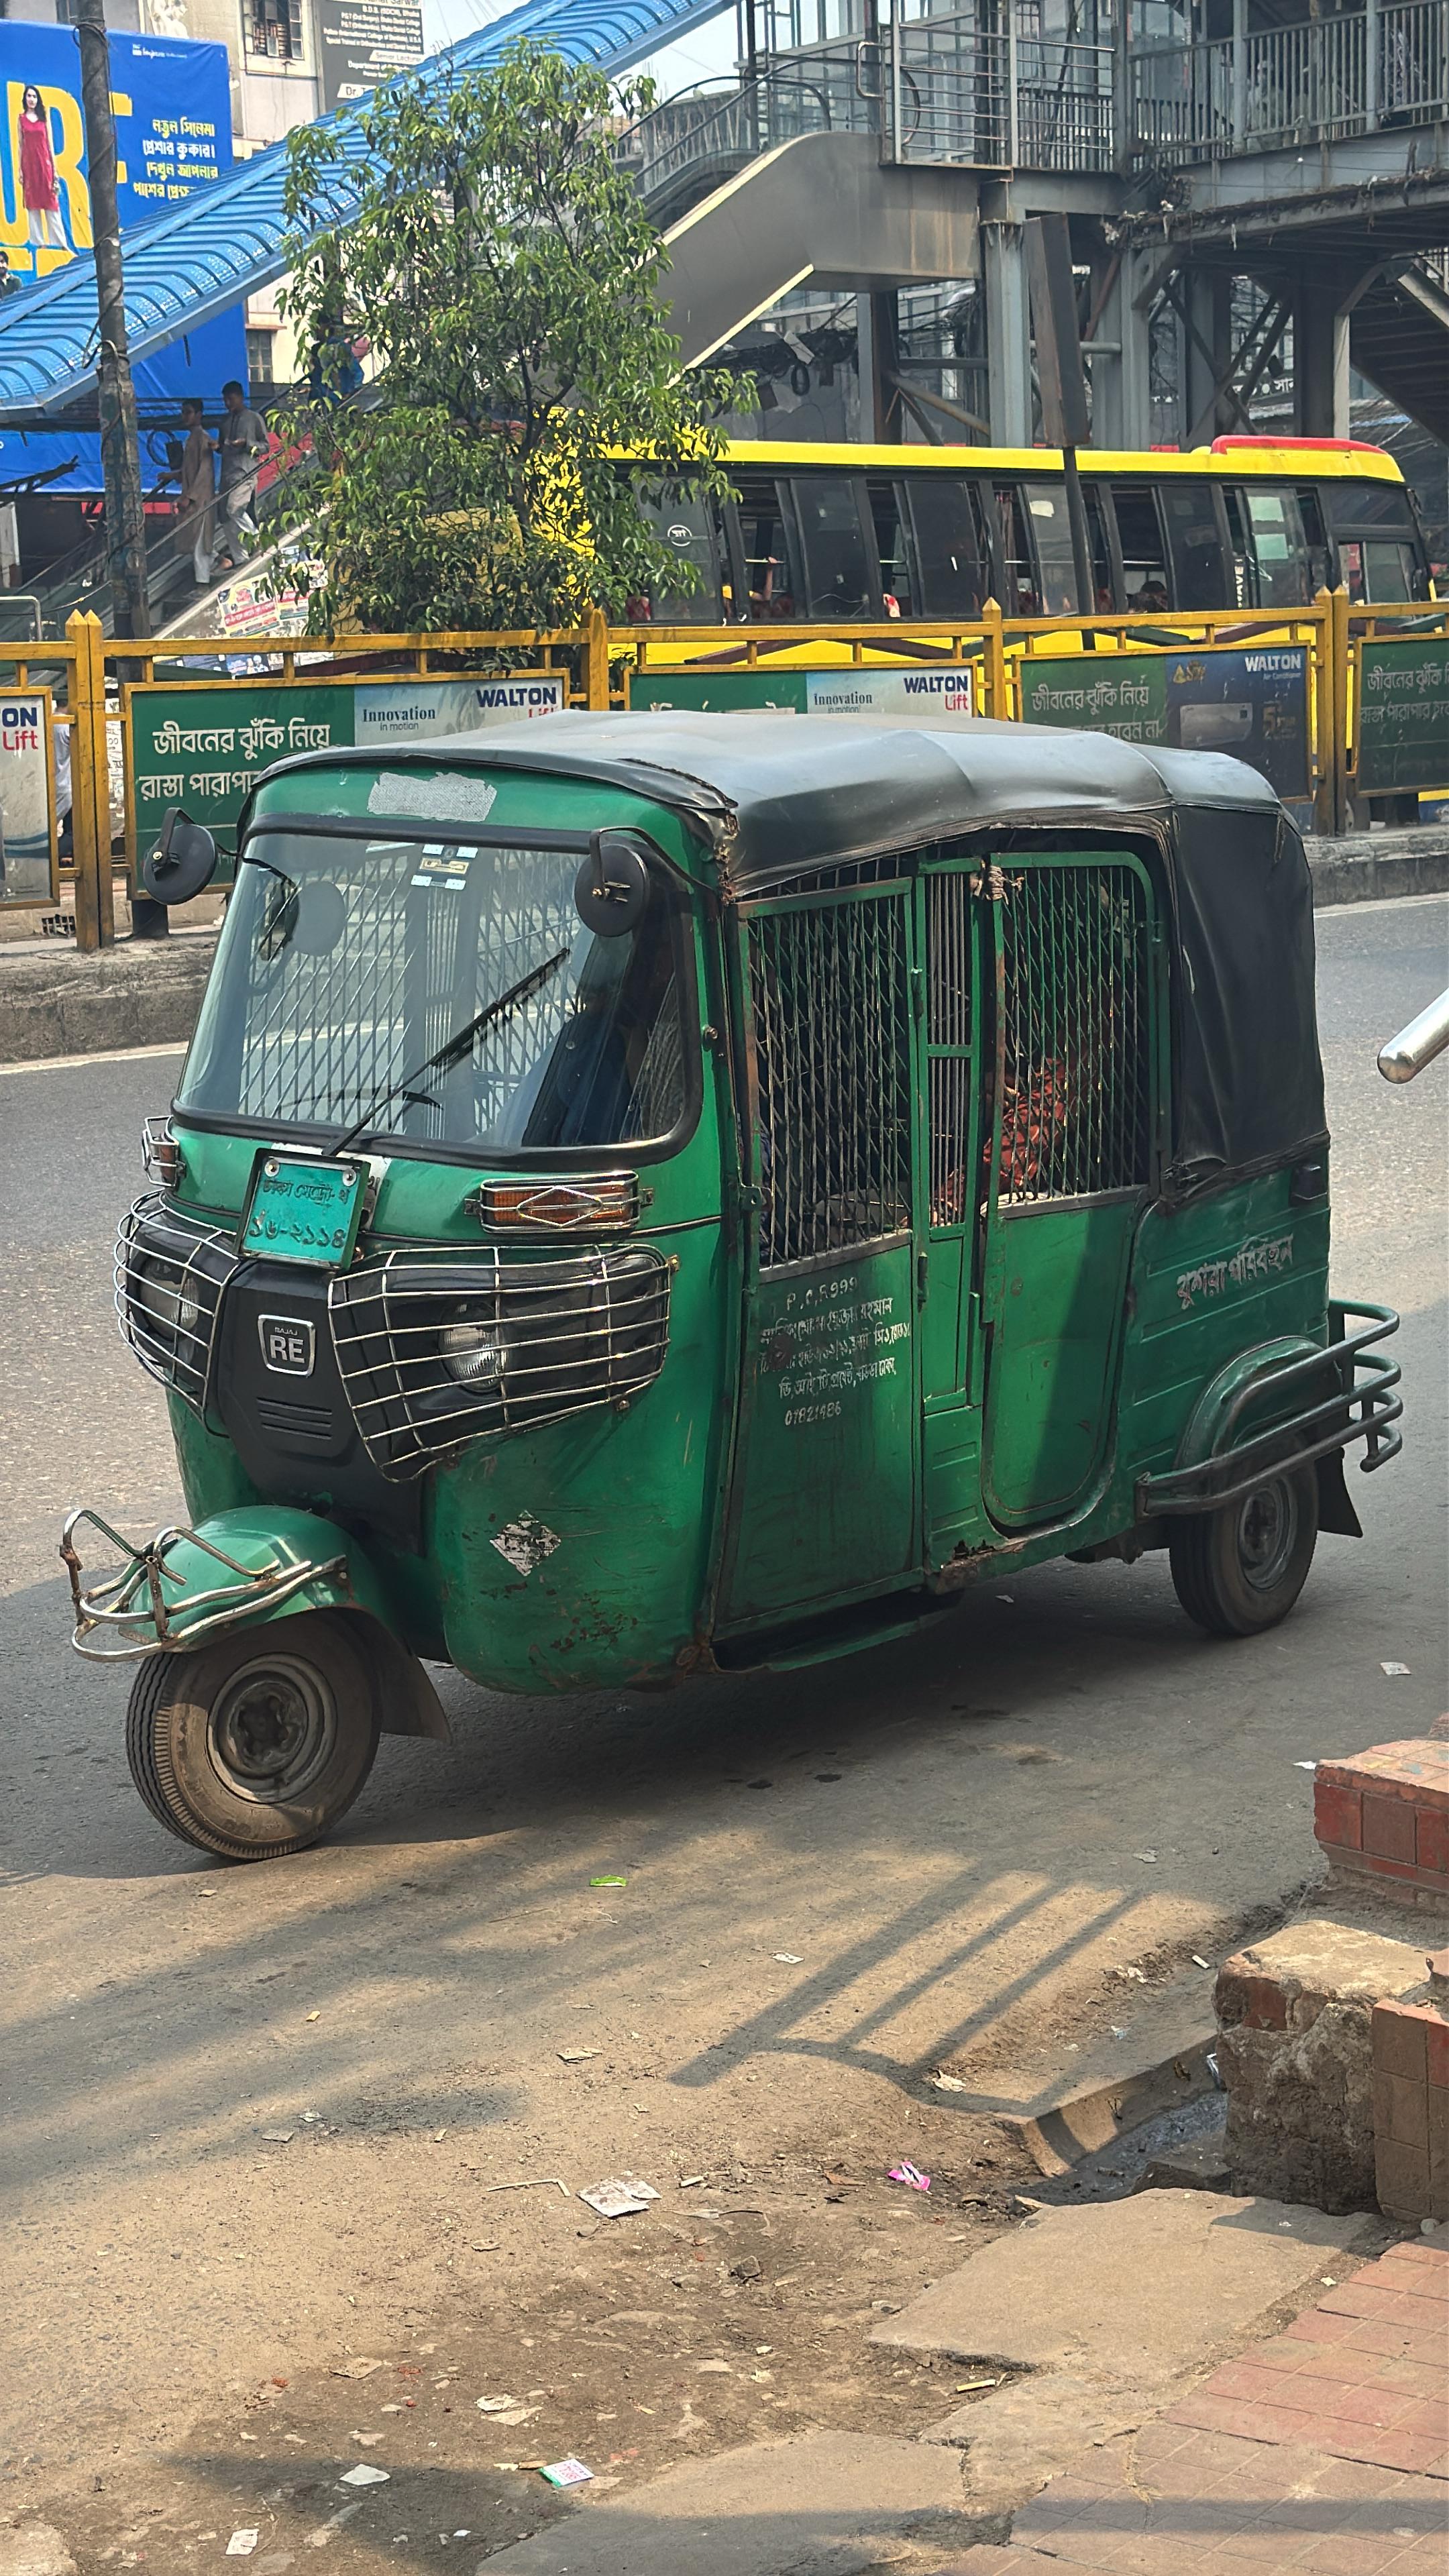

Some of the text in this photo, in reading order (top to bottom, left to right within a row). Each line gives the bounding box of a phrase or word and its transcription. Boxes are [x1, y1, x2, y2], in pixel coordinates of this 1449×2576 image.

[152, 117, 215, 139] নতুন সিনেমা
[142, 140, 174, 156] প্রেশার
[177, 164, 218, 180] আপনার
[133, 182, 165, 199] পাশের
[1245, 653, 1301, 672] WALTON
[904, 676, 968, 693] WALTON
[476, 687, 556, 708] WALTON
[814, 691, 872, 706] Innovation
[945, 694, 968, 711] Lift
[1031, 680, 1150, 716] জীবনের ঝুঁকি নিয়ে
[362, 706, 435, 722] Innovation
[380, 722, 419, 731] in motion
[2, 730, 38, 751] Lift
[152, 720, 235, 755] জীবনের
[237, 717, 285, 761] ঝুঁকি
[288, 717, 331, 750] নিয়ে
[138, 771, 262, 802] রাস্তা পারাপা
[262, 1179, 294, 1197] ঢাকা
[274, 1327, 298, 1336] BAJAJ
[270, 1334, 305, 1364] RE
